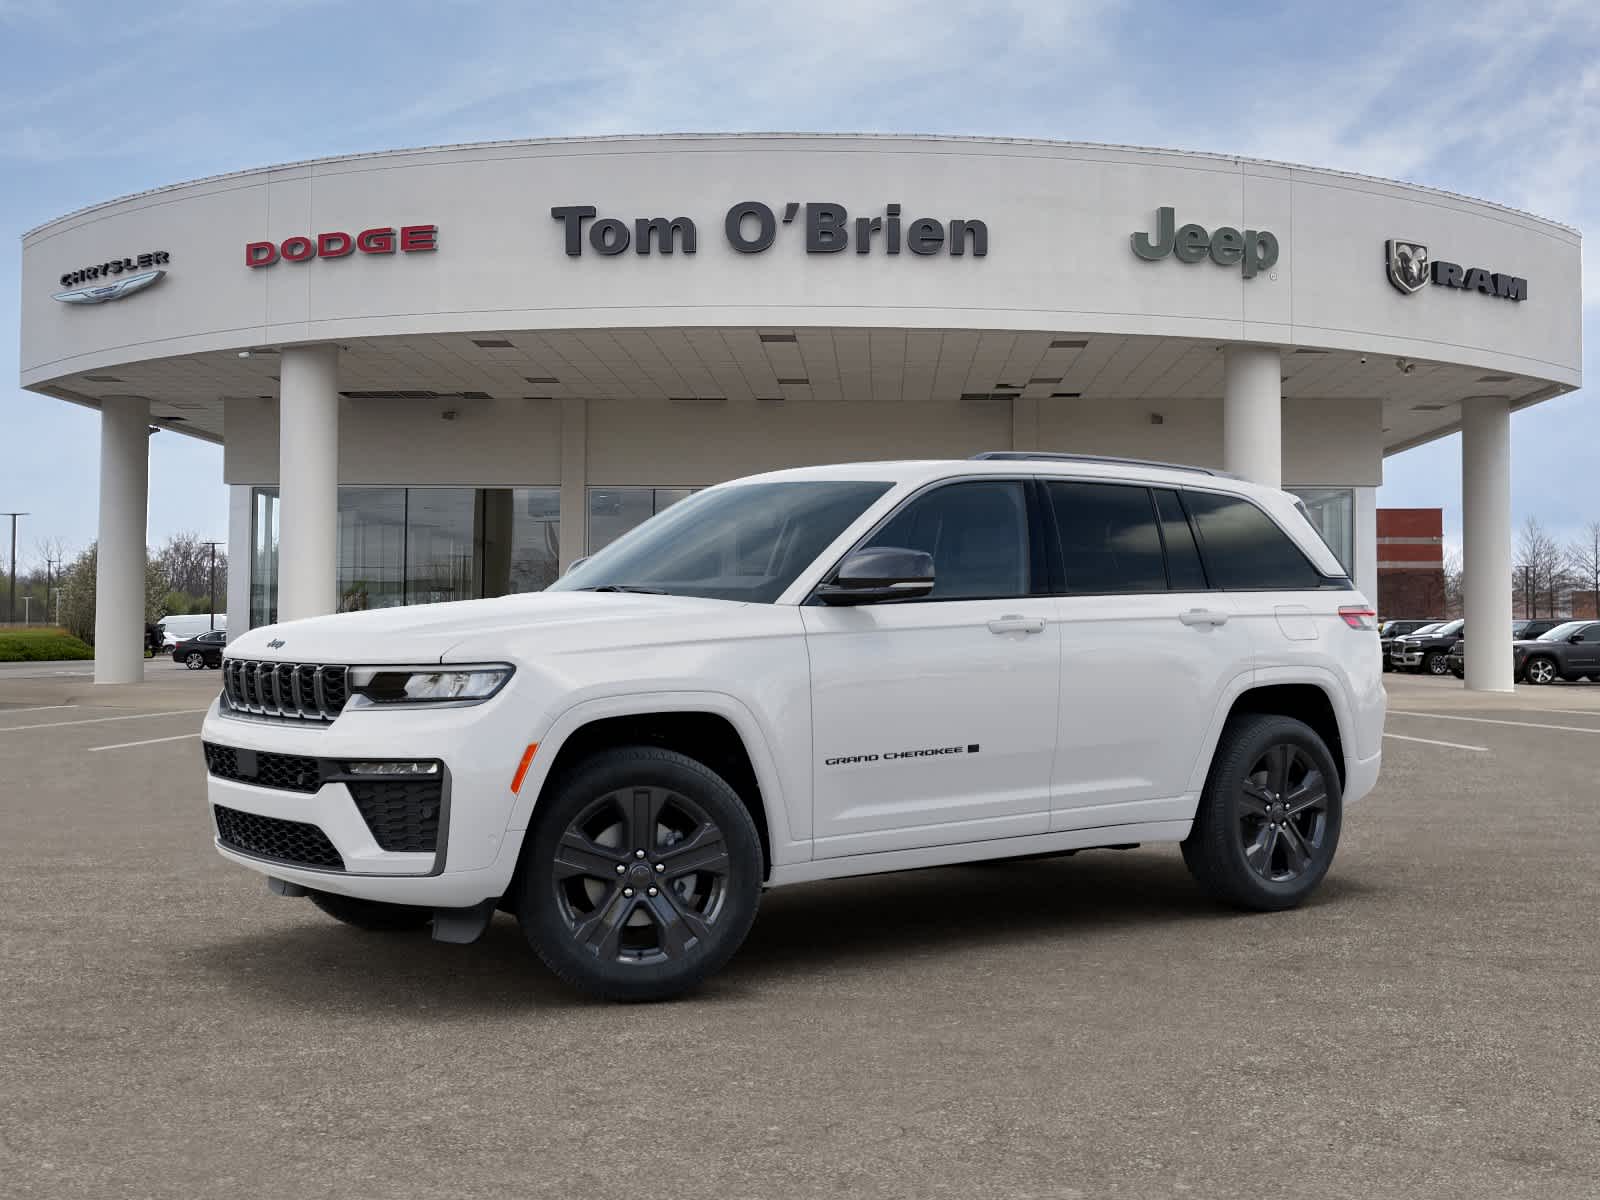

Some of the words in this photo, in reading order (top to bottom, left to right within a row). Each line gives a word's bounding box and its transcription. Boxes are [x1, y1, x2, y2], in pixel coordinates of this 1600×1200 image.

[245, 225, 438, 268] DODGE
[551, 205, 697, 257] Tom
[725, 201, 989, 257] O'Brien
[1130, 206, 1279, 279] Jeep
[60, 250, 170, 287] CHRYSLER
[1430, 260, 1528, 301] RAM
[825, 754, 879, 766] GRAND
[883, 746, 964, 760] CHEROKEE
